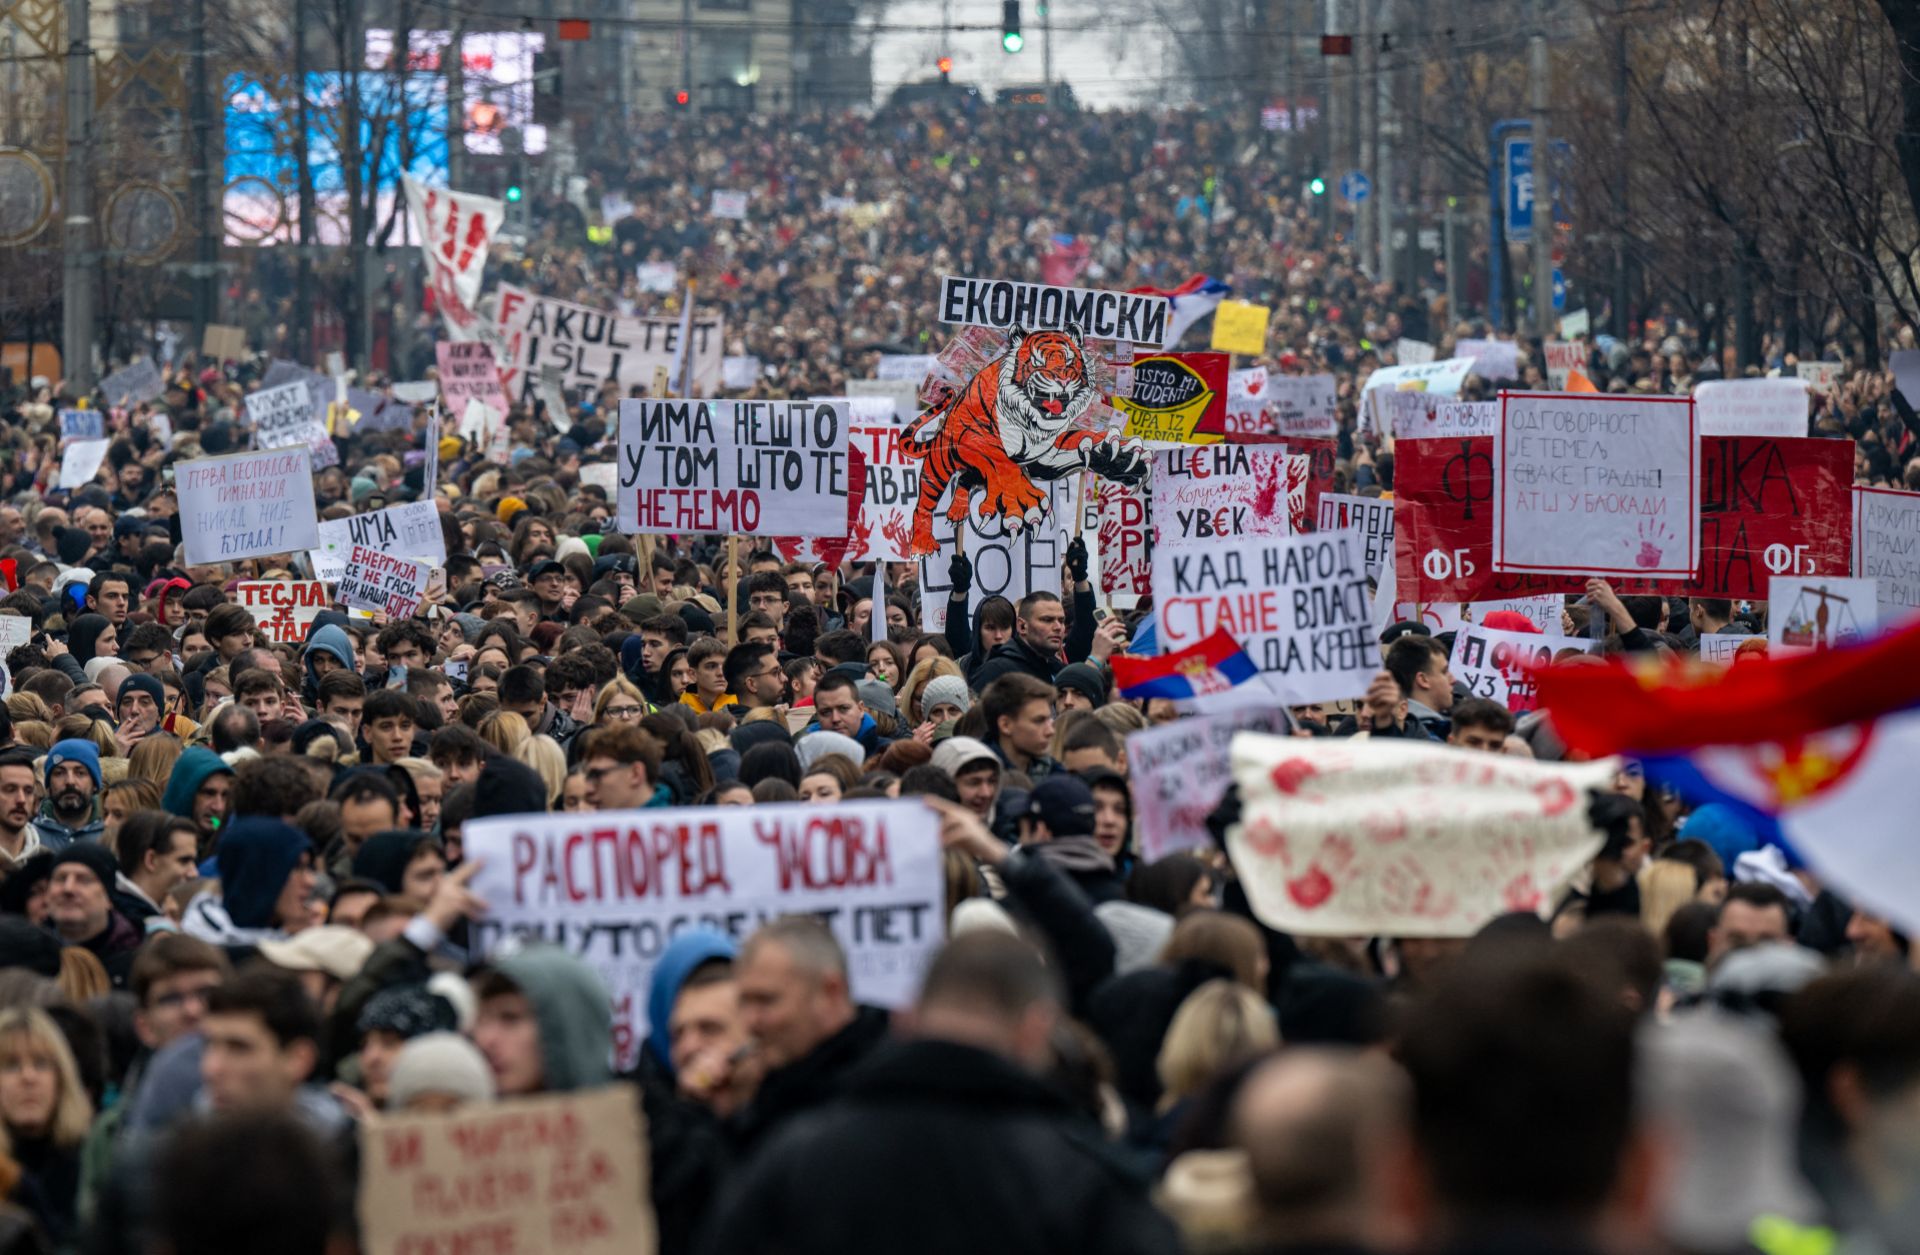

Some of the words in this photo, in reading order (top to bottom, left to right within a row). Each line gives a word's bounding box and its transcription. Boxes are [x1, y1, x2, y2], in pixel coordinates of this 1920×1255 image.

[945, 278, 1166, 345] ЕКОНОМСКИ
[1180, 375, 1198, 392] MI
[641, 402, 715, 444] ИМА
[735, 402, 838, 449] НЕШТО
[1168, 413, 1185, 432] IZ
[1512, 409, 1641, 435] ОДГОВОРНОСТ
[187, 464, 227, 491] ПРВА
[621, 443, 646, 488] У
[655, 445, 719, 488] ТОМ
[738, 447, 802, 492] ШТО
[809, 450, 848, 497] ТЕ
[217, 478, 286, 503] ГИМНАЗИЈА
[1585, 493, 1666, 516] БЛОКАДИ
[197, 506, 246, 533] НИКАД
[259, 499, 295, 524] НИЈЕ
[637, 488, 761, 532] НЕЋЕМО
[348, 511, 397, 546] ИМА
[1866, 529, 1916, 554] ГРАДИ
[345, 563, 360, 578] СЕ
[363, 568, 382, 586] НЕ
[351, 545, 417, 582] ЕНЕРГИЈА
[1172, 549, 1248, 594] КАД
[1263, 539, 1355, 586] НАРОД
[1423, 548, 1475, 581] ФБ
[1763, 543, 1816, 575] ФБ
[238, 581, 327, 607] ТЕСЛА
[340, 578, 358, 595] НИ
[358, 584, 390, 608] НАША
[271, 606, 295, 622] ЈЕ
[1161, 591, 1279, 641] СТАНЕ
[1292, 580, 1370, 631] ВЛАСТ
[1261, 634, 1306, 675] ДА
[1463, 671, 1497, 698] УЗ
[513, 822, 731, 904] РАСПОРЕД
[755, 817, 893, 893] ЧАСОВА
[852, 902, 930, 945] ПЕТ
